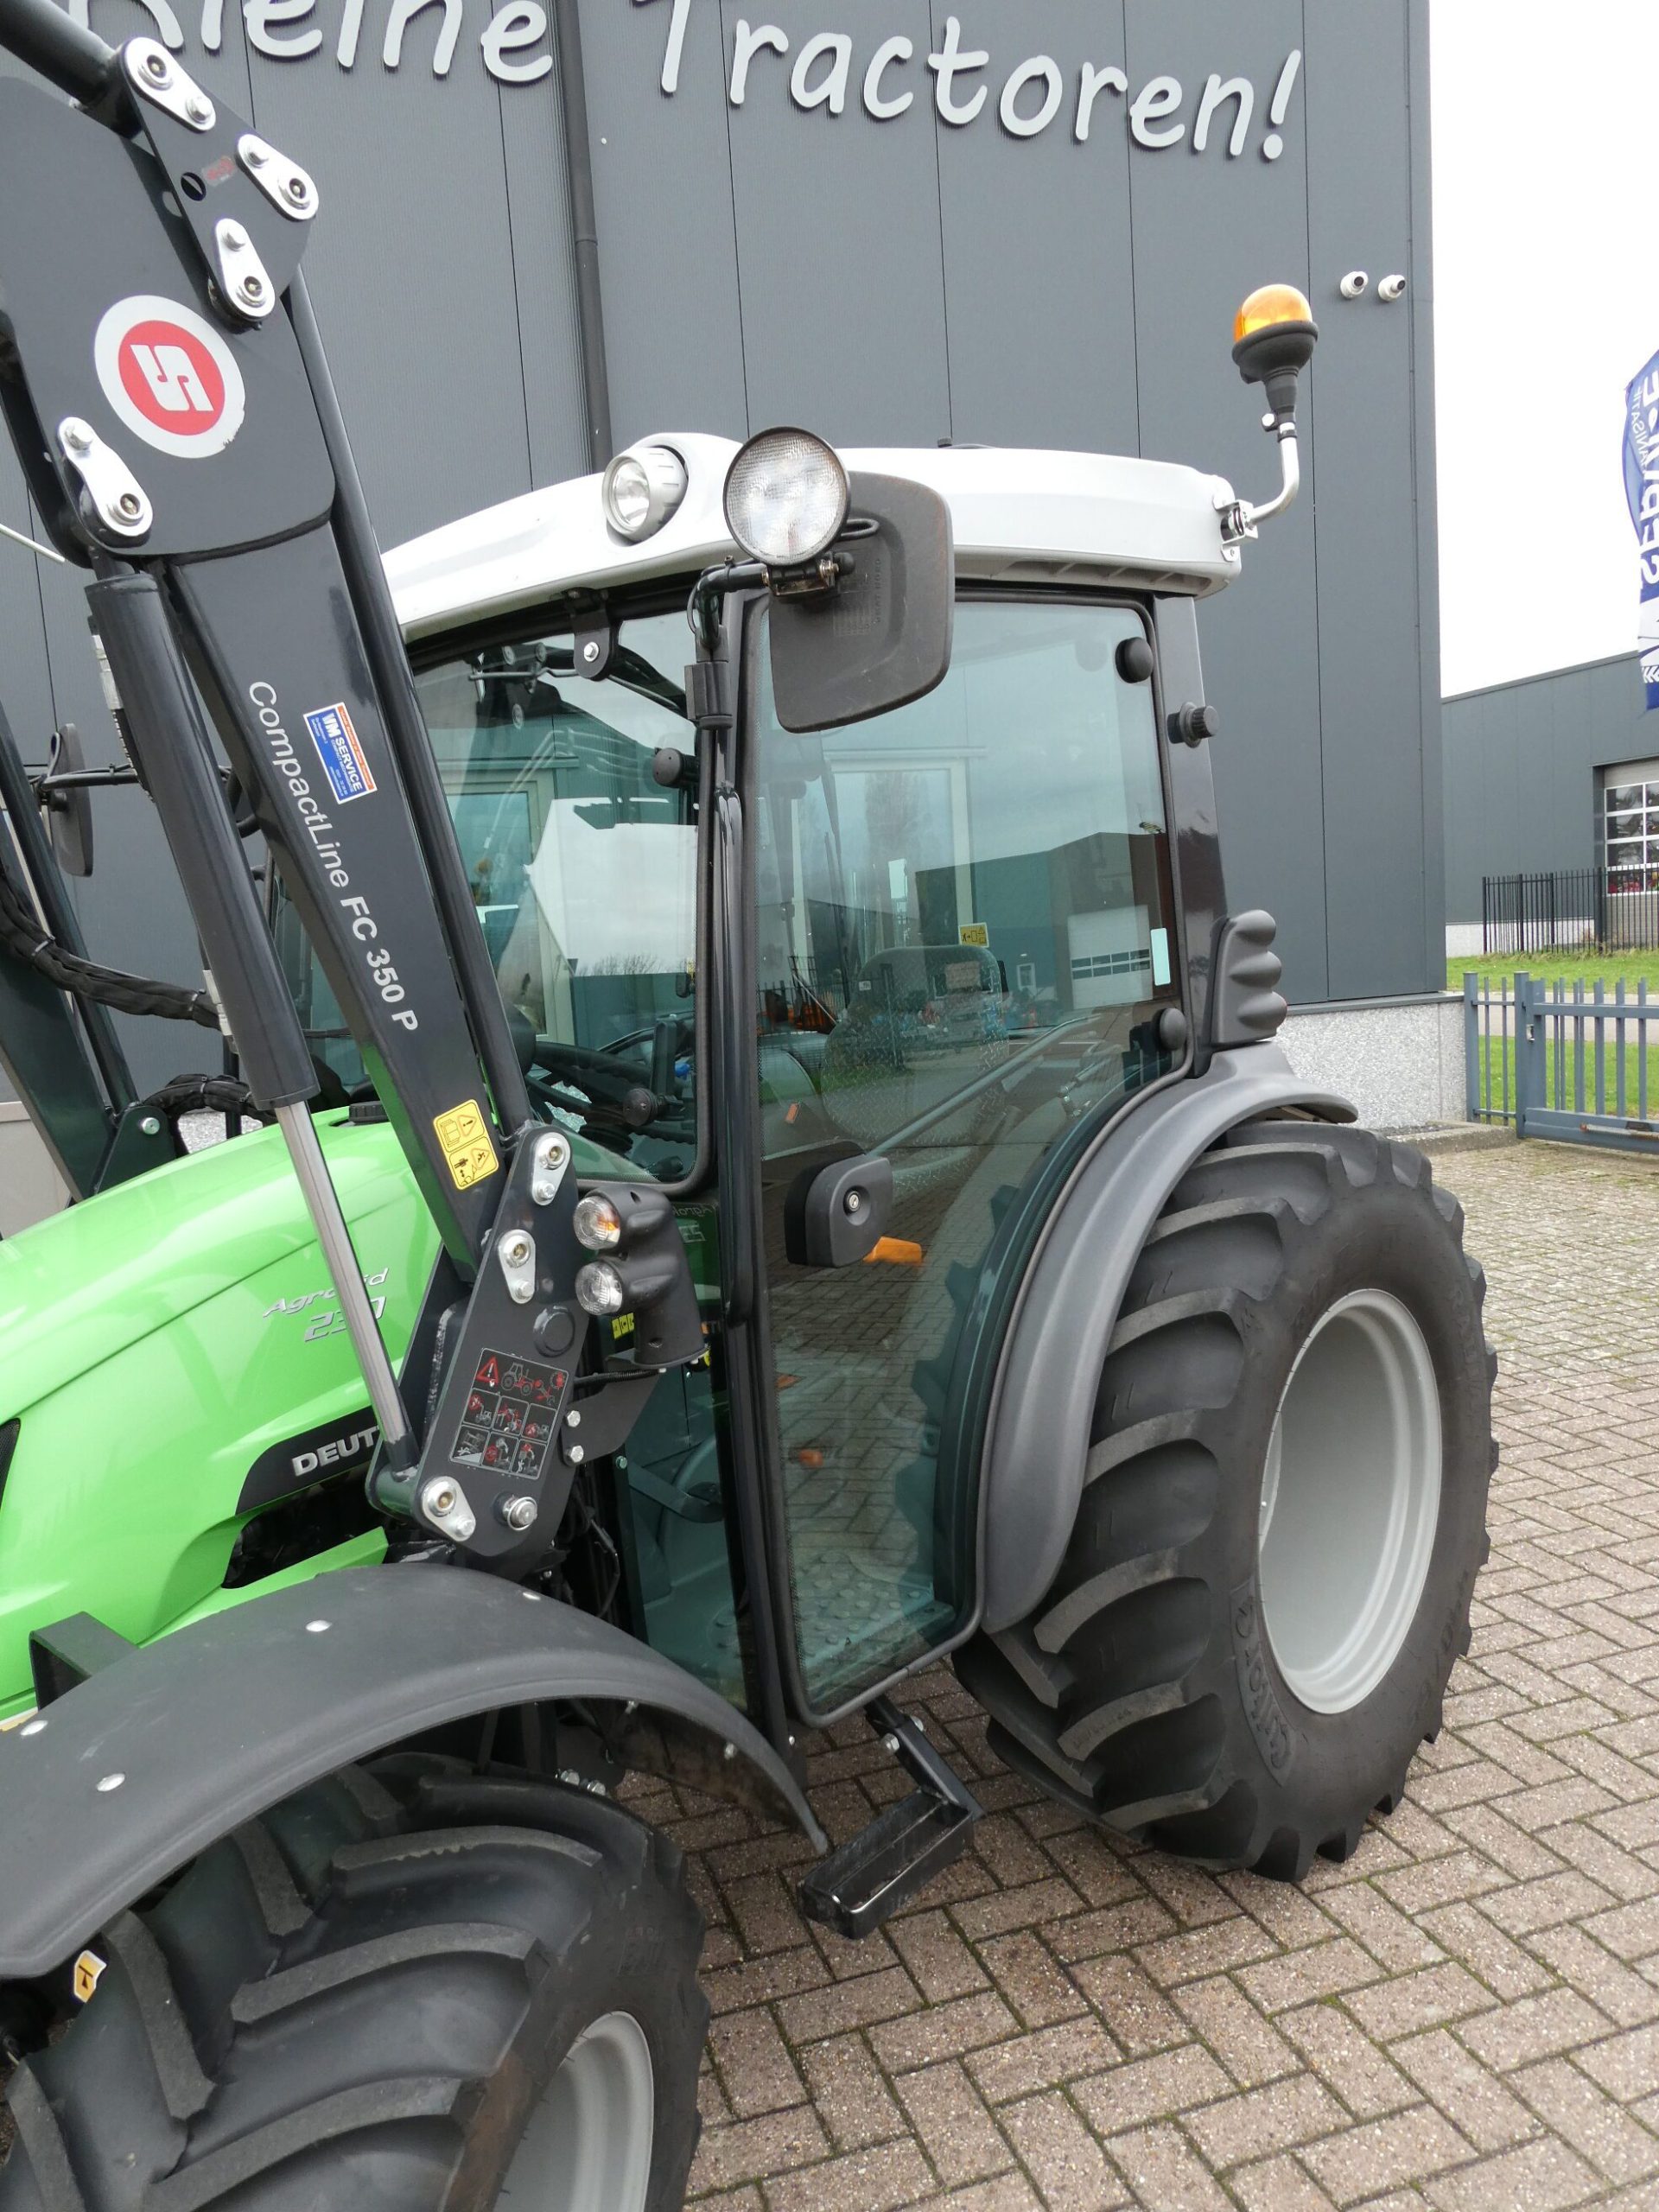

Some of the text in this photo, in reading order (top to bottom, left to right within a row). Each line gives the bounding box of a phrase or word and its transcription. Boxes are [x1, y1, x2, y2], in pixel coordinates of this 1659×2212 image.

[632, 0, 1302, 162] Tractoren!
[334, 736, 364, 792] SERVICE
[248, 680, 419, 1032] CompactLine FC 350 P
[262, 1267, 390, 1319] Agroid
[291, 1425, 380, 1478] DEUT
